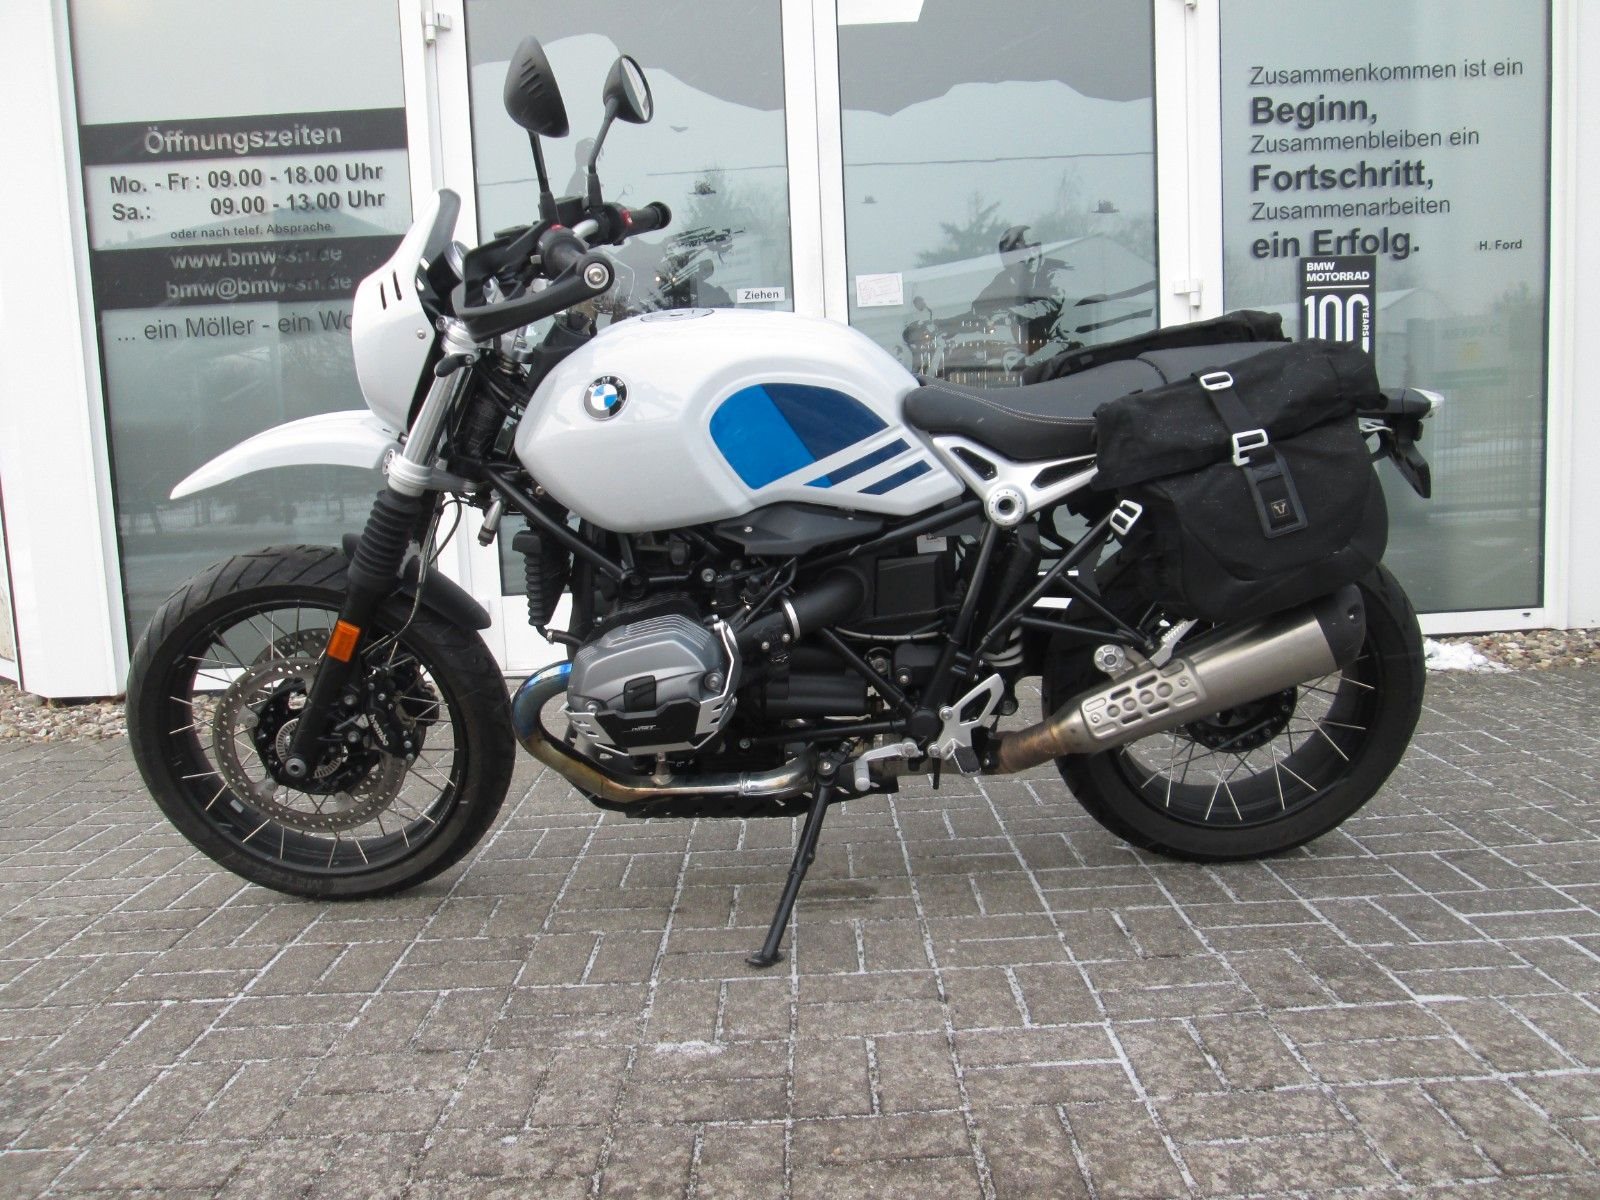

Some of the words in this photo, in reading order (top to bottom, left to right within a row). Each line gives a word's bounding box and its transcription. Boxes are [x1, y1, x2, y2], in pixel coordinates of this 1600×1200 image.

[1250, 63, 1457, 86] Zusammenkommen
[1463, 59, 1487, 78] ist
[1493, 57, 1524, 77] ein
[1252, 94, 1378, 130] Beginn,
[144, 124, 342, 155] Öffnungszeiten
[1251, 129, 1442, 154] Zusammenbleiben
[1450, 126, 1480, 146] ein
[110, 176, 147, 194] Mo.
[208, 168, 263, 189] 09.00
[283, 164, 338, 185] 18.00
[345, 163, 384, 181] Uhr
[1252, 159, 1434, 193] Fortschritt,
[210, 196, 265, 216] 09.00
[287, 192, 341, 212] 13.00
[348, 190, 385, 208] Uhr
[1251, 196, 1451, 221] Zusammenarbeiten
[170, 229, 197, 240] oder
[201, 227, 230, 239] nach
[266, 222, 332, 238] Absprache
[1252, 230, 1300, 259] ein
[1313, 227, 1420, 260] Erfolg.
[1479, 240, 1491, 251] H.
[1494, 239, 1523, 251] Ford
[1306, 261, 1335, 271] BMW
[1306, 271, 1370, 282] MOTORRAD
[744, 290, 779, 300] Ziehen
[144, 321, 177, 340] ein
[186, 316, 254, 338] Möller
[278, 312, 311, 333] ein
[319, 309, 353, 331] Wo
[1304, 293, 1370, 351] 100
[1362, 304, 1370, 337] YEARS
